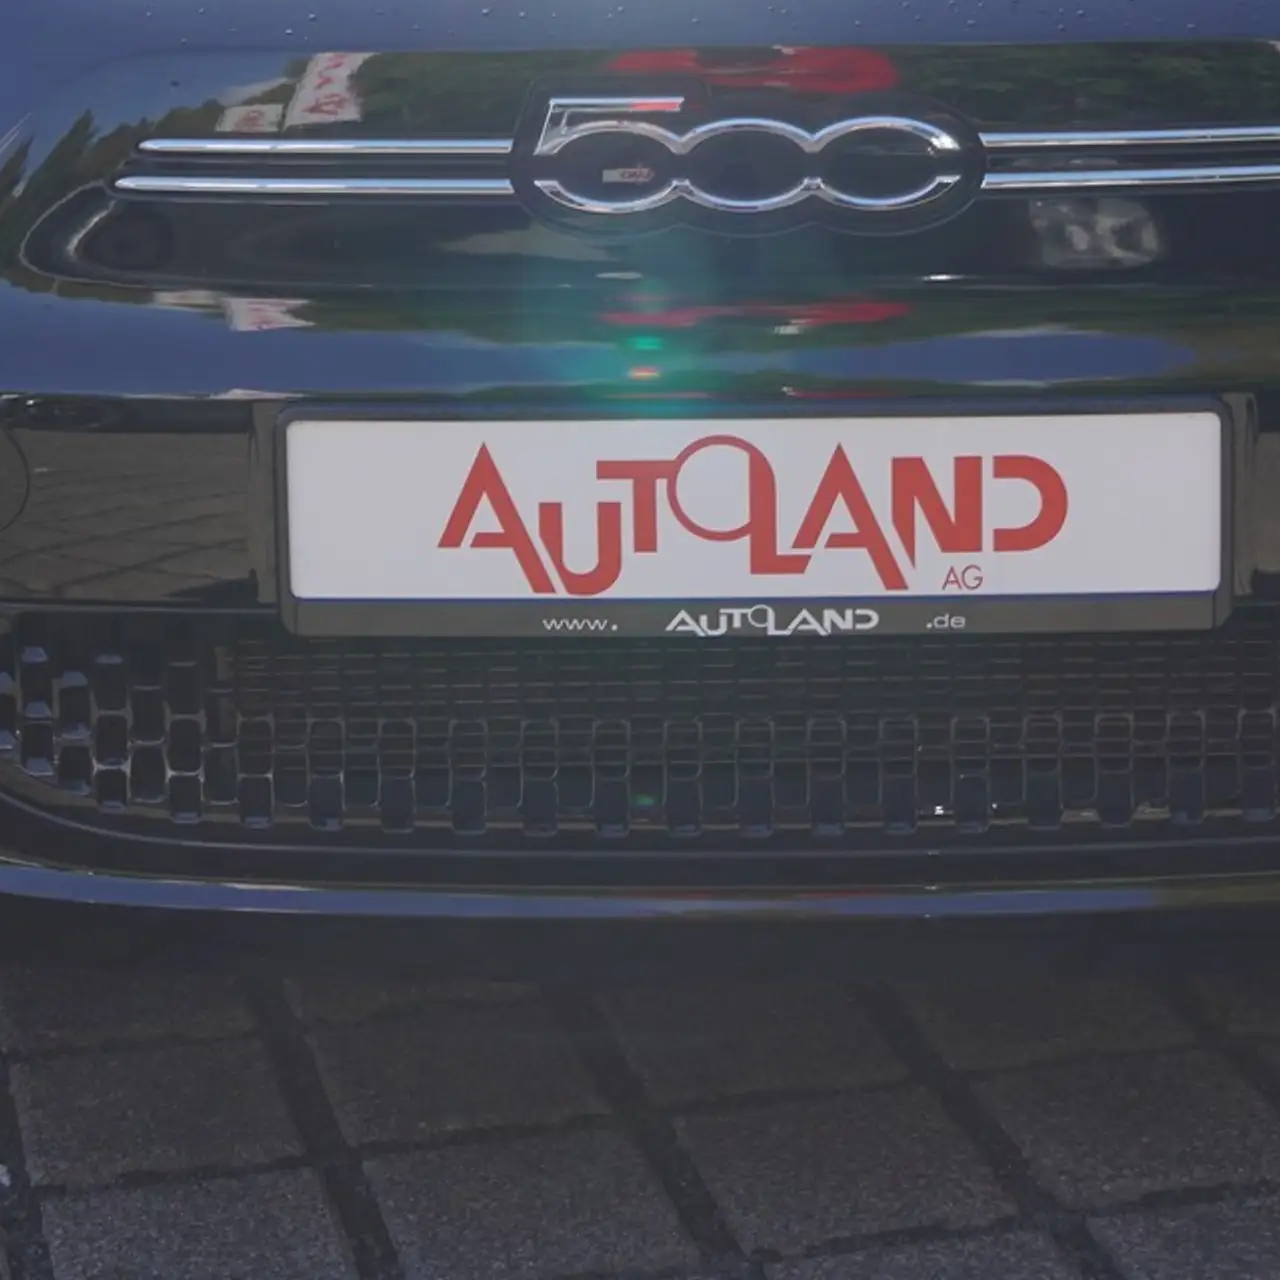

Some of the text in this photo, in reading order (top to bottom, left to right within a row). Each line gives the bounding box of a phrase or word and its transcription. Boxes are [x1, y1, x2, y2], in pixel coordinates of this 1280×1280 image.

[534, 97, 961, 212] 500
[438, 434, 1069, 596] AUTOLAND
[942, 565, 984, 590] AG
[542, 604, 966, 636] www. AUTOLAND .de
